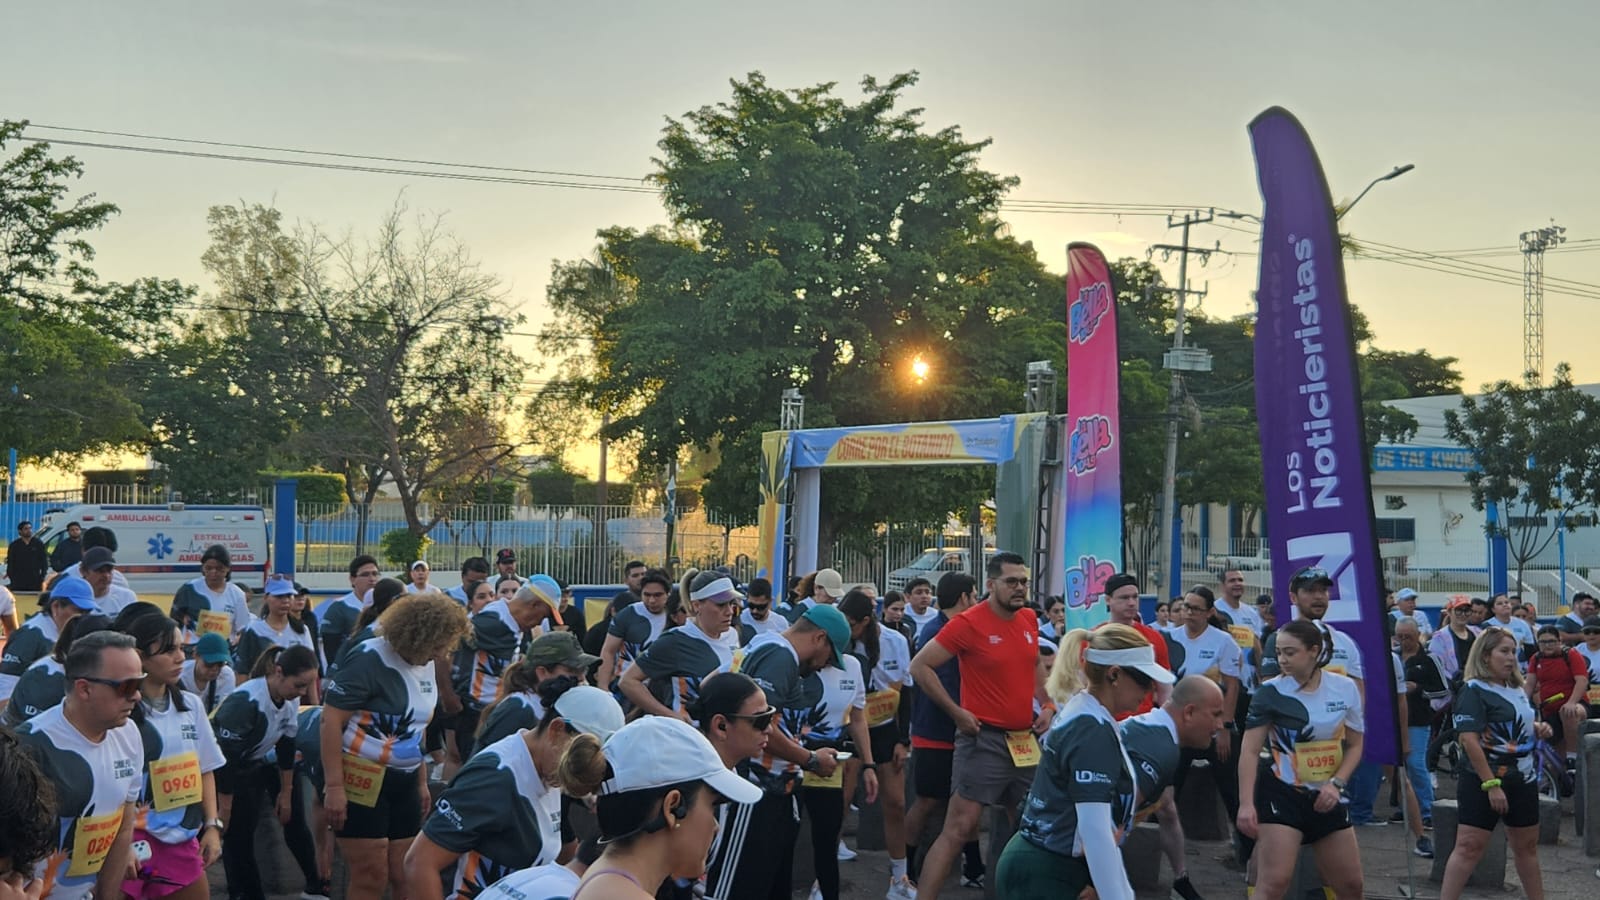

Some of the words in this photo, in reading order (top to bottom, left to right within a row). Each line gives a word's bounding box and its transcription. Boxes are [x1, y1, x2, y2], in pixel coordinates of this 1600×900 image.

[1293, 238, 1341, 508] Noticieristas
[837, 436, 866, 460] CORRE
[868, 436, 889, 460] POR
[889, 435, 900, 459] EL
[1377, 450, 1394, 468] DE
[1399, 450, 1425, 468] TAE
[107, 514, 172, 522] AMBULANCIA
[178, 553, 255, 562] AMBCIAS
[1307, 755, 1336, 768] 0395
[162, 774, 197, 794] 0967
[343, 772, 373, 790] 538
